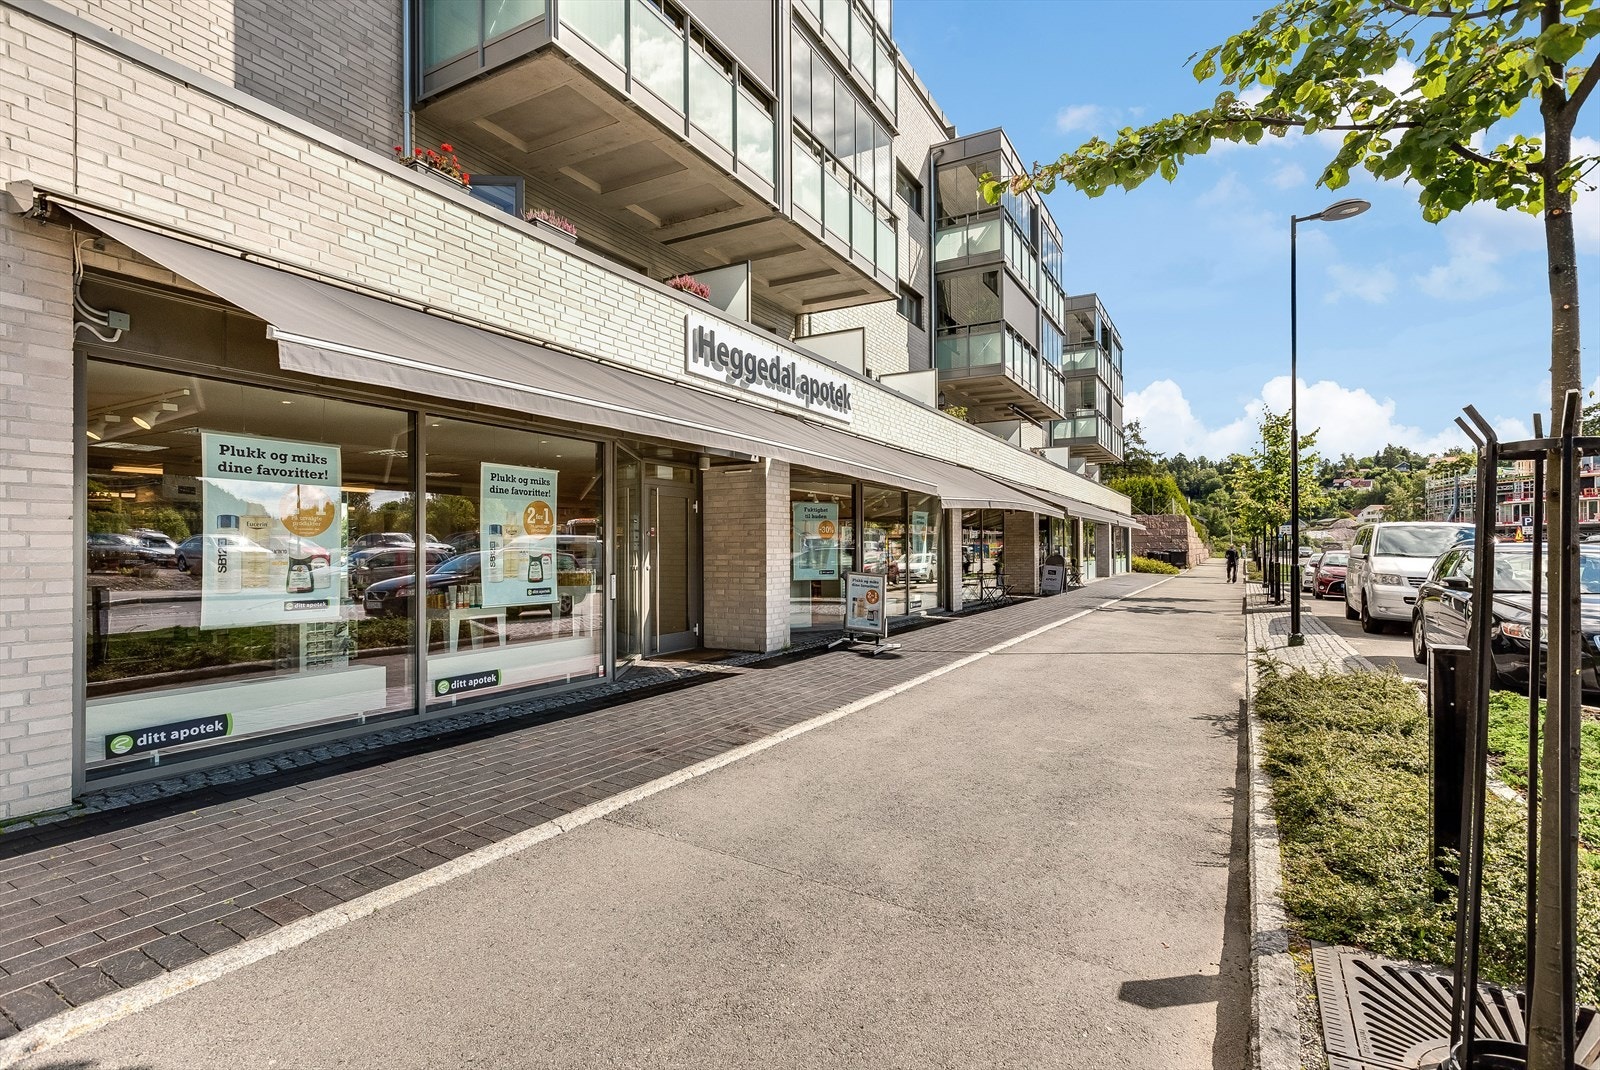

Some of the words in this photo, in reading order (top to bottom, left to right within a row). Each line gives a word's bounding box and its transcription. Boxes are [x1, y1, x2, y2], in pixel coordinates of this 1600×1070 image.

[697, 325, 796, 391] Heggedal
[800, 374, 851, 410] apotek
[219, 444, 266, 459] Plukk
[270, 452, 288, 464] og
[291, 453, 328, 465] miks
[217, 461, 253, 474] dine
[256, 464, 328, 480] favoritter!
[490, 472, 516, 483] Plukk
[518, 477, 529, 486] og
[530, 477, 551, 486] miks
[489, 485, 509, 495] dine
[511, 486, 551, 498] favoritter!
[527, 507, 536, 524] 2
[543, 507, 550, 525] 1
[1524, 517, 1532, 526] P
[819, 526, 834, 534] -30%
[450, 679, 467, 690] ditt
[468, 674, 497, 687] apotek
[136, 732, 167, 747] ditt
[169, 720, 223, 741] apotek
